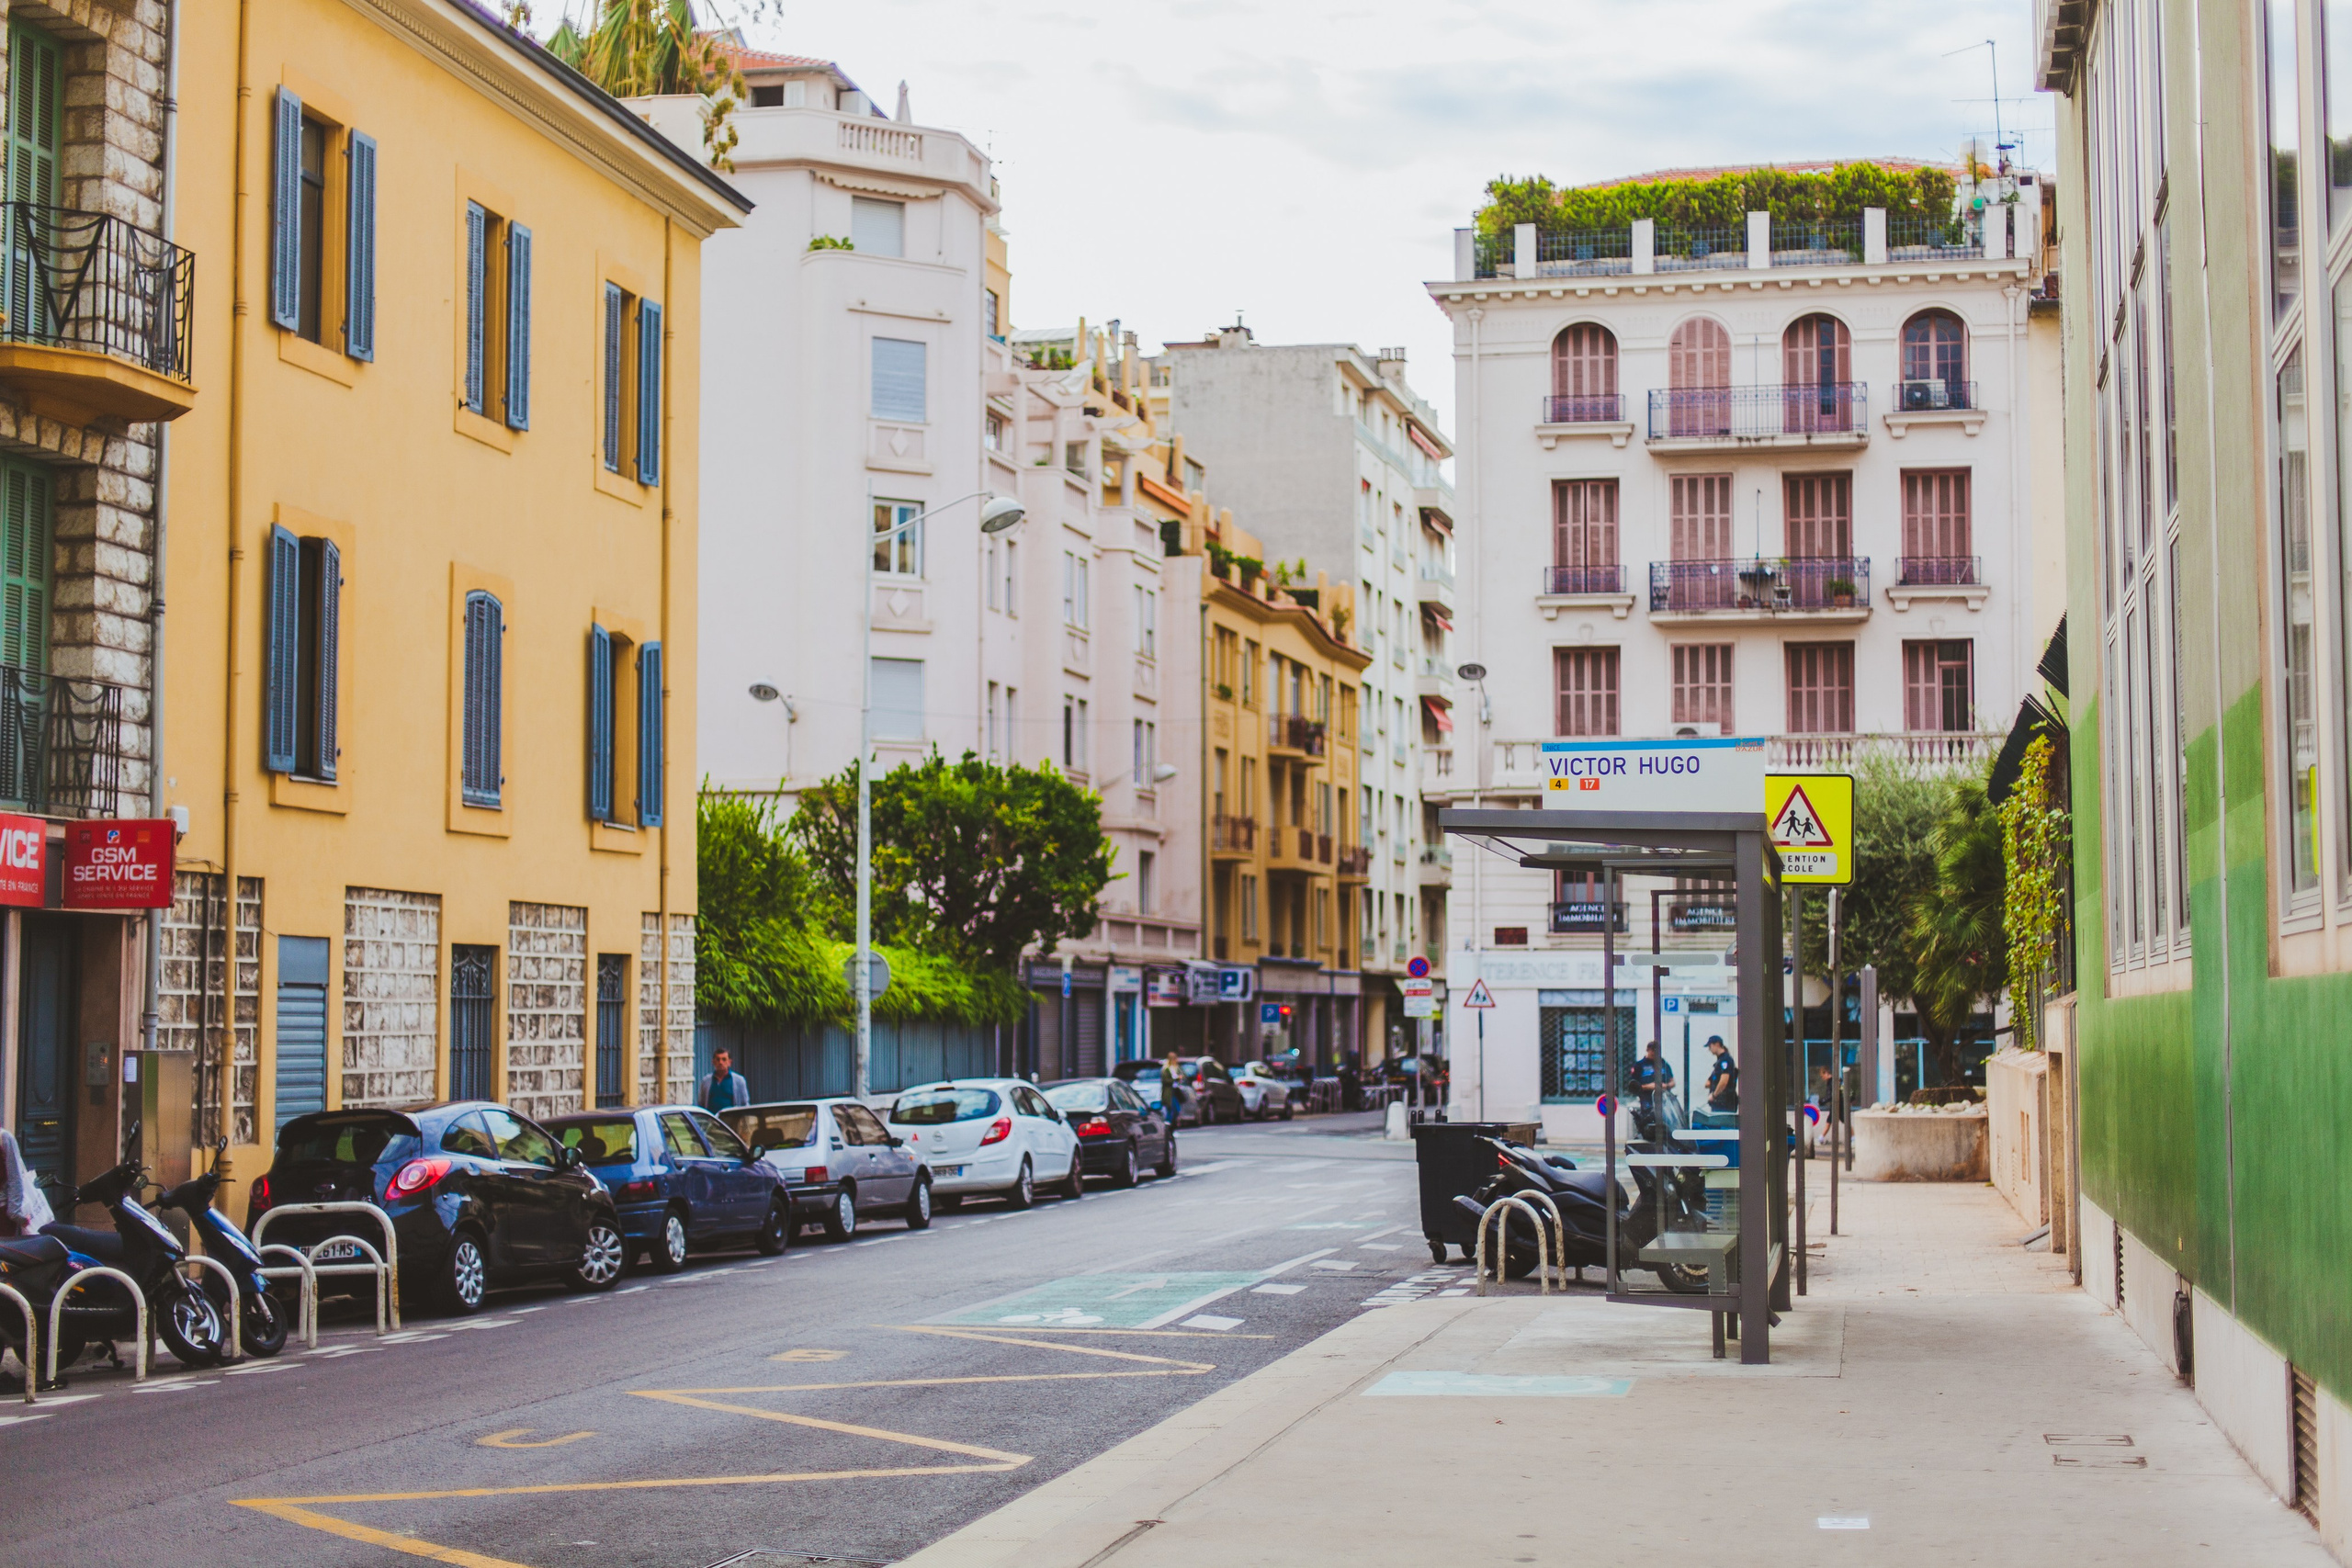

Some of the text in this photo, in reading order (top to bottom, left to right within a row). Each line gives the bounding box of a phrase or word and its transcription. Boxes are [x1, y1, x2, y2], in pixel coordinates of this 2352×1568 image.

[1549, 756, 1700, 776] VICTOR HUGO
[1555, 779, 1595, 789] 4 17
[92, 847, 136, 864] GSM
[74, 864, 157, 882] SERVICE
